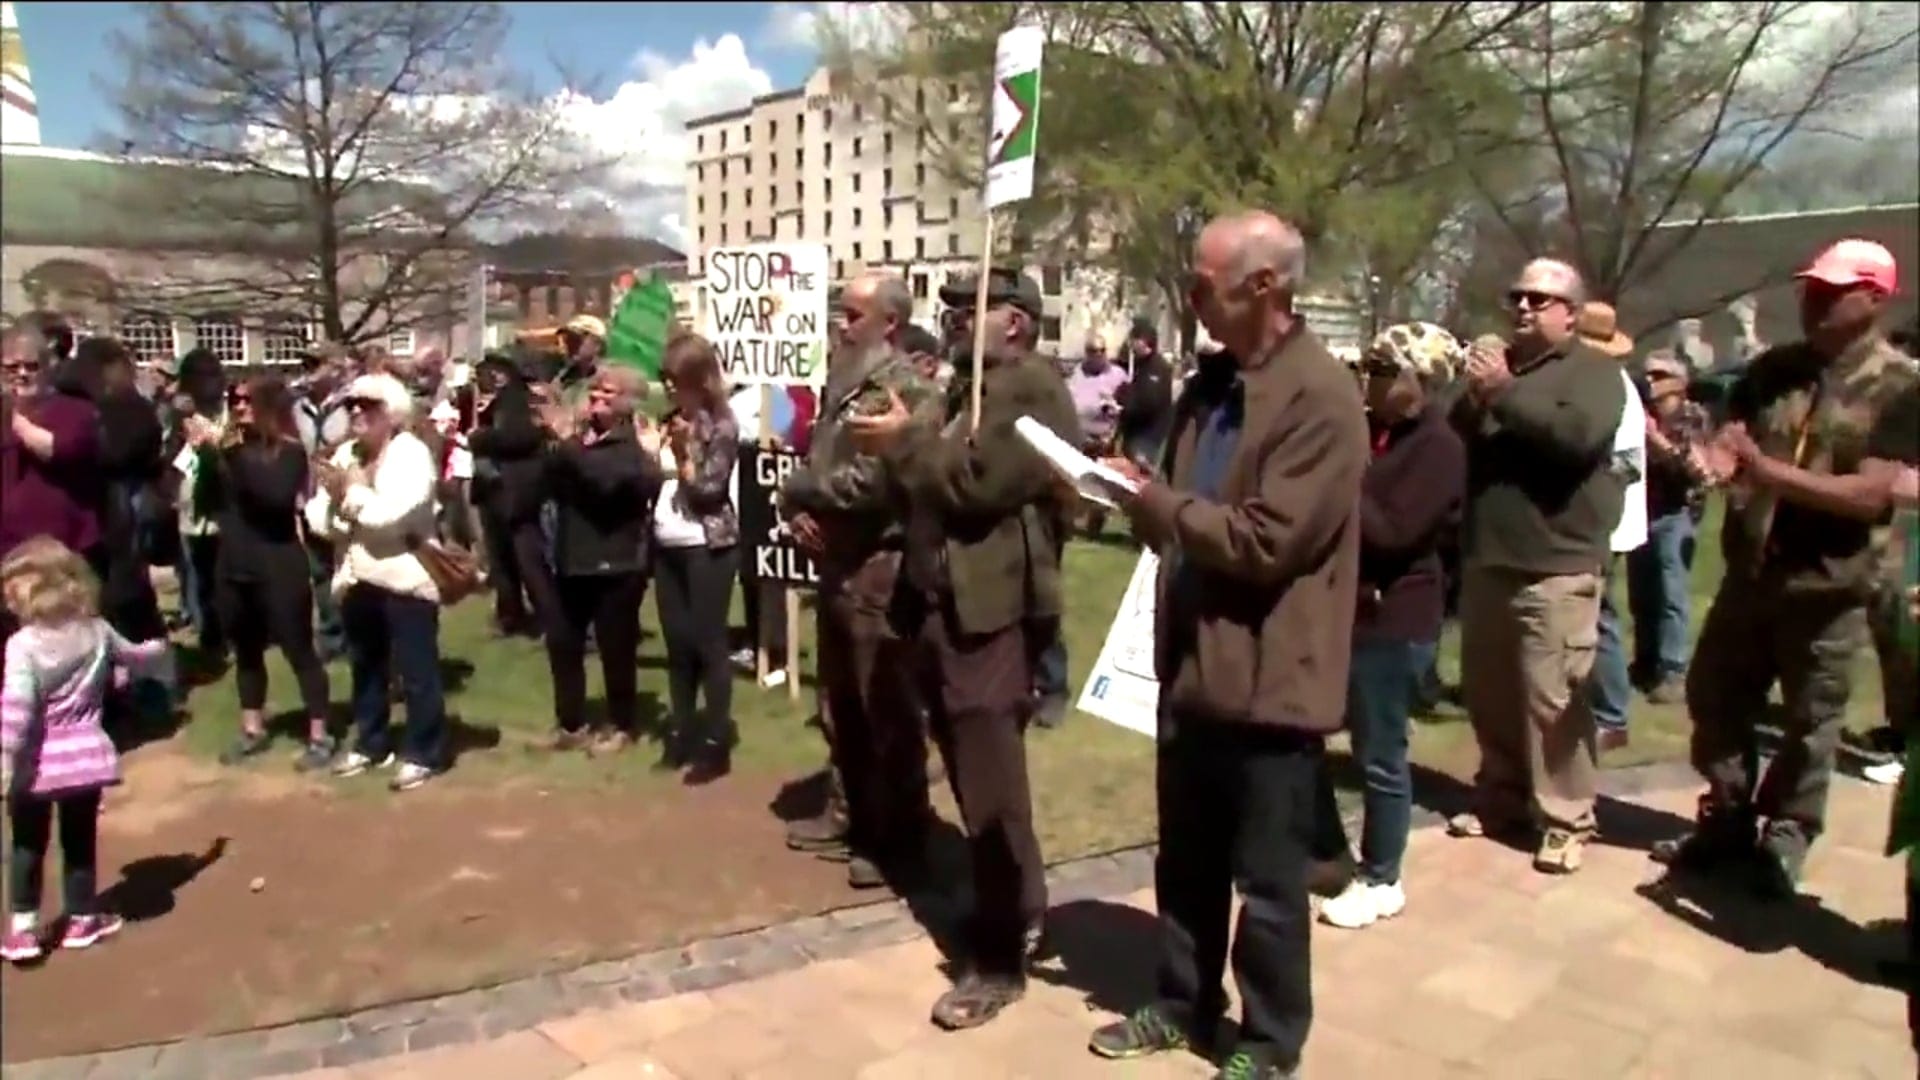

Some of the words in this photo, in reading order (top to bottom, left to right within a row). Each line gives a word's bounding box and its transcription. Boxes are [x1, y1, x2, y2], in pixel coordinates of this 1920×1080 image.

[710, 250, 792, 294] STOP
[788, 270, 815, 292] THE
[711, 296, 774, 335] WAR
[786, 312, 817, 335] ON
[711, 340, 812, 378] NATURE
